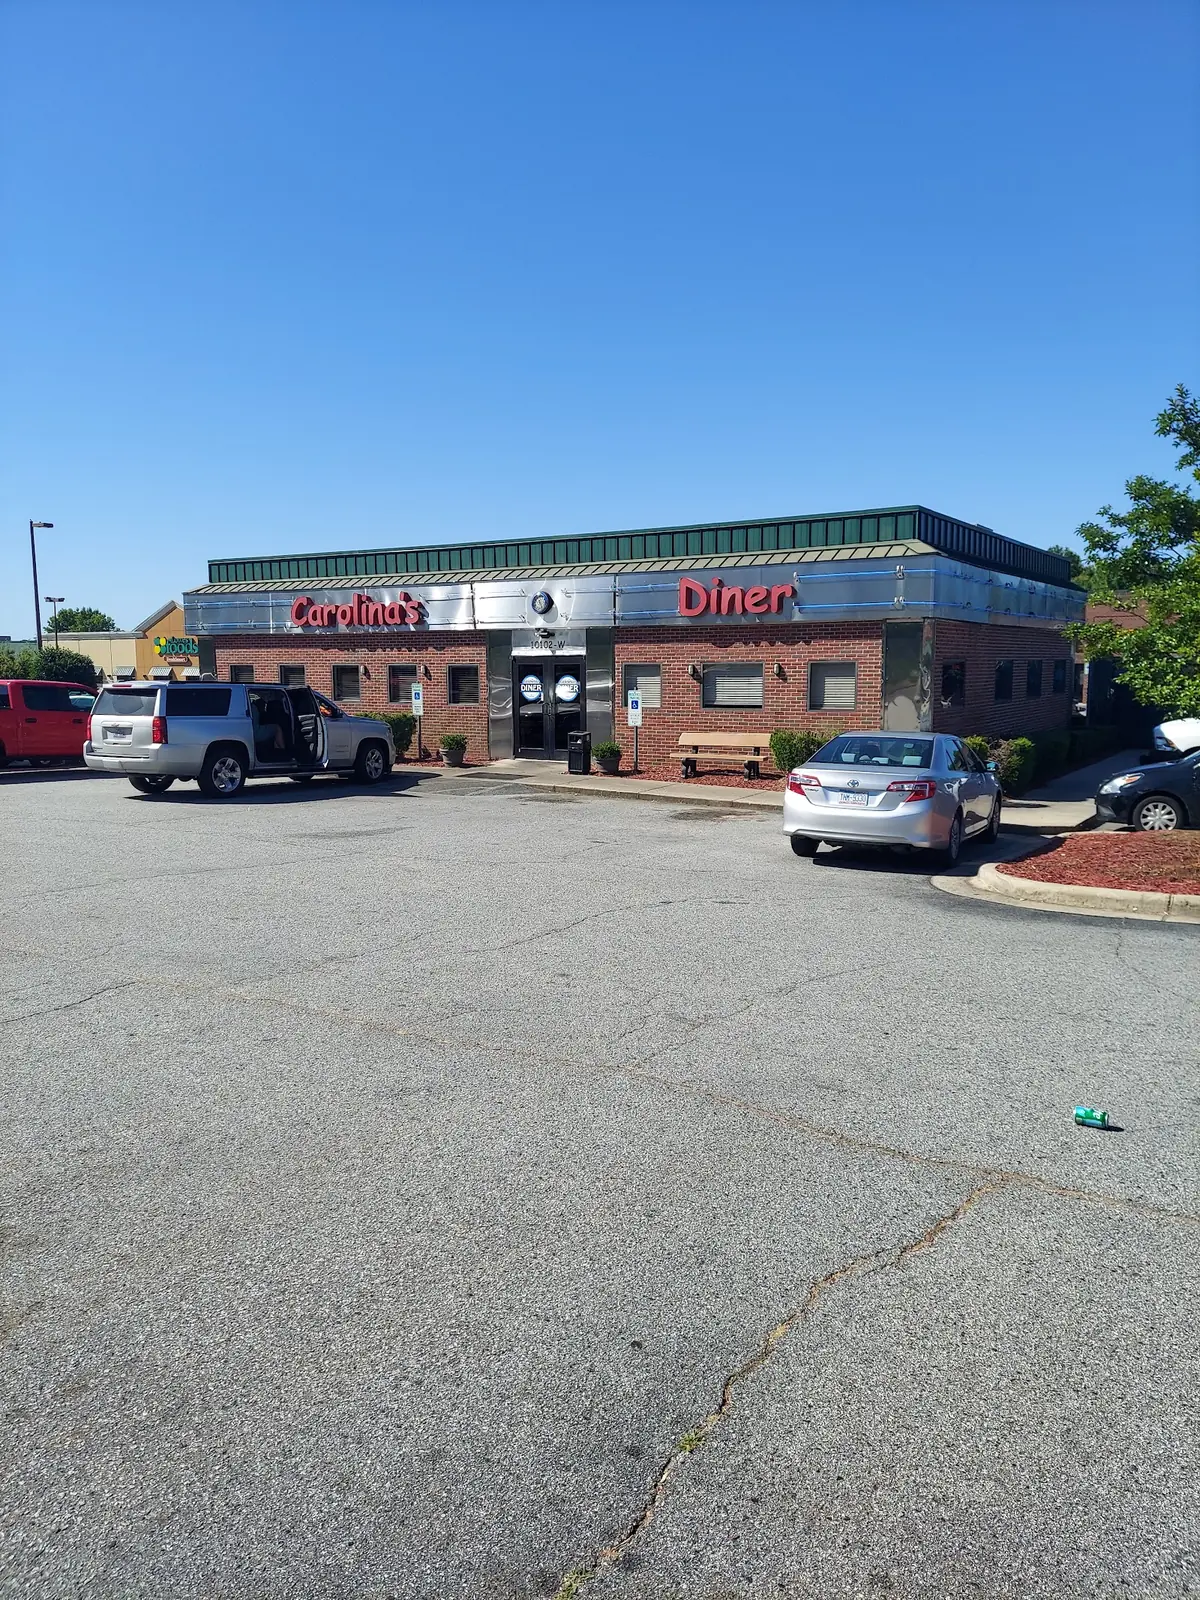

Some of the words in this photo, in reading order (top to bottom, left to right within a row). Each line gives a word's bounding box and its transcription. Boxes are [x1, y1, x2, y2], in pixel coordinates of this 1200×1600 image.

[678, 576, 793, 617] Diner
[291, 591, 420, 627] Carolina's
[167, 637, 199, 654] foods
[530, 640, 566, 649] 10102-W
[520, 684, 542, 692] DINER
